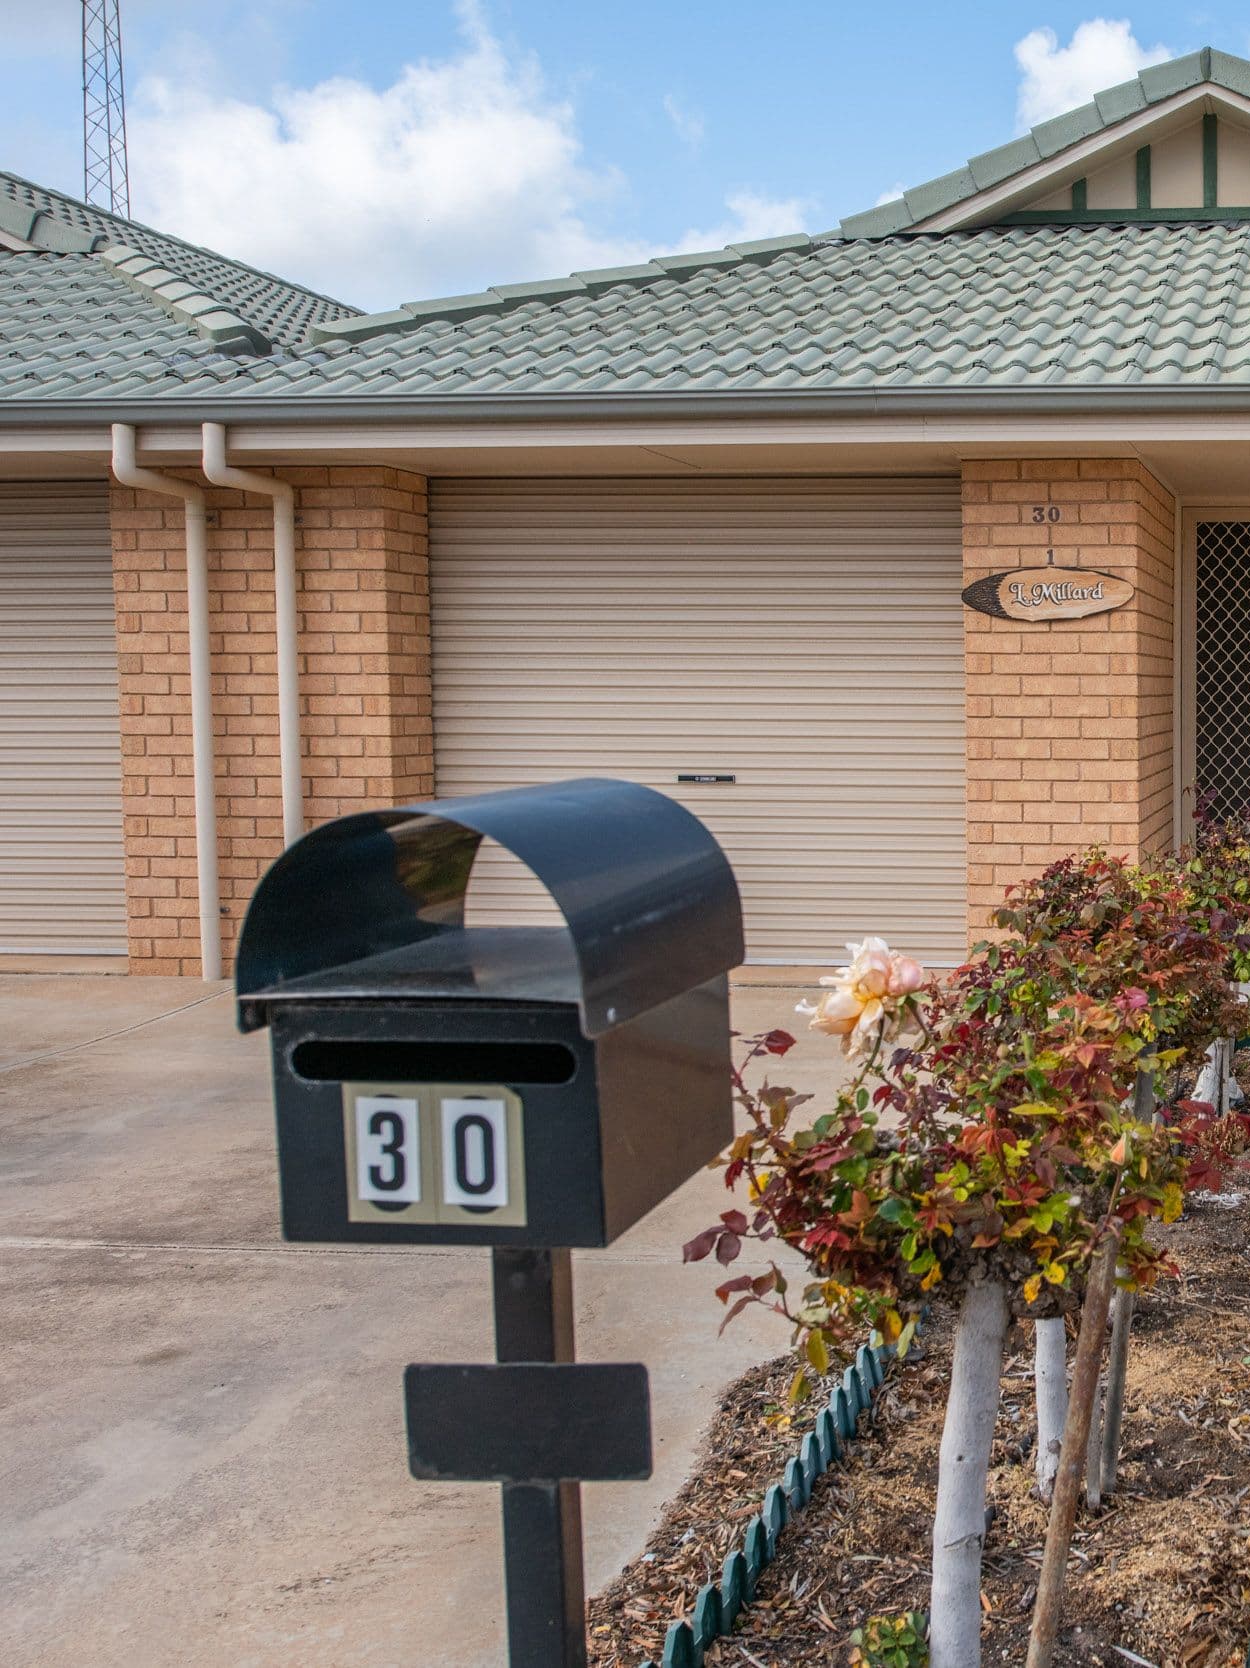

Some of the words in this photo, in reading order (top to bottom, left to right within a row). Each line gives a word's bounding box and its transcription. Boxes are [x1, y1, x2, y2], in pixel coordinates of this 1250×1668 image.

[1032, 506, 1061, 523] 30
[1046, 549, 1055, 566] 1
[1031, 581, 1104, 606] Millard
[368, 1110, 496, 1195] 30
